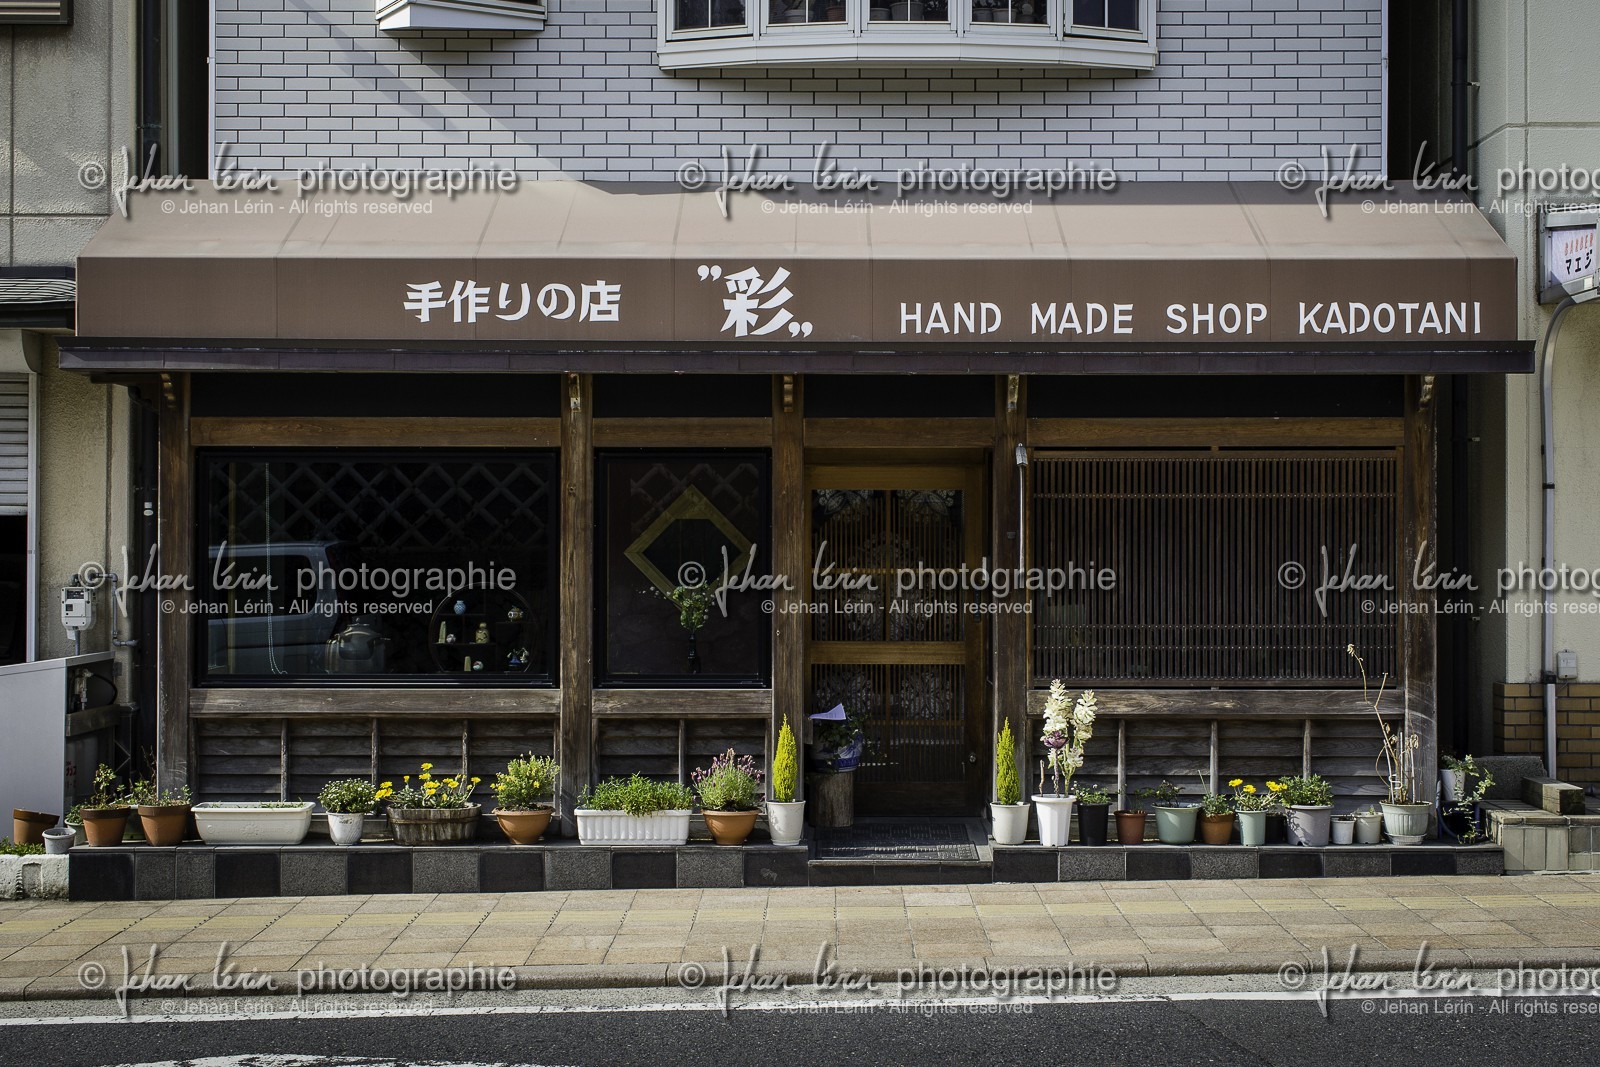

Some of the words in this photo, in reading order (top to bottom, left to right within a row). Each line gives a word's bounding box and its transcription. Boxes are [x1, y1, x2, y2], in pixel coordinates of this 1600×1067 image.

[1565, 249, 1593, 275] マエジ
[404, 280, 621, 323] 手作りの店
[901, 302, 1001, 334] HAND
[1032, 303, 1133, 334] MADE
[1167, 303, 1267, 334] SHOP
[1300, 302, 1480, 334] KADOTANI
